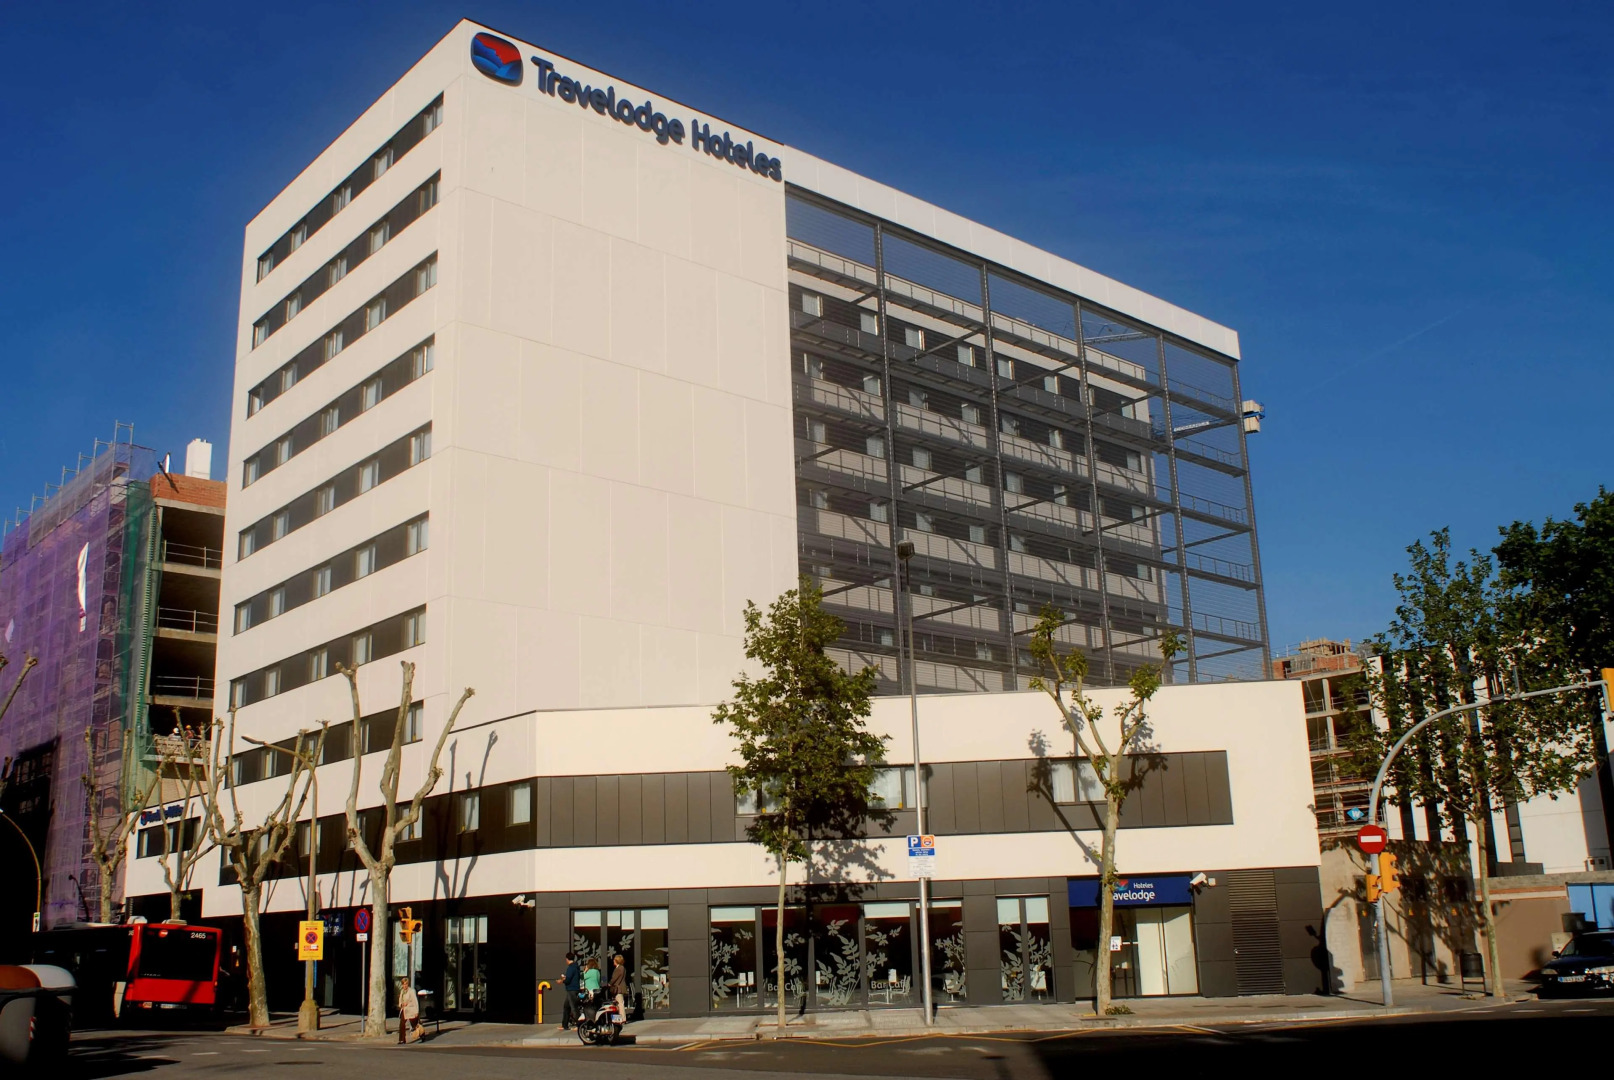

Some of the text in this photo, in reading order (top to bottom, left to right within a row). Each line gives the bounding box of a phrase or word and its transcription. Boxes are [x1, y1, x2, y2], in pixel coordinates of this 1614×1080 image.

[531, 56, 782, 182] Travelodge Hoteles
[911, 837, 918, 847] P
[1113, 890, 1155, 901] avelodge
